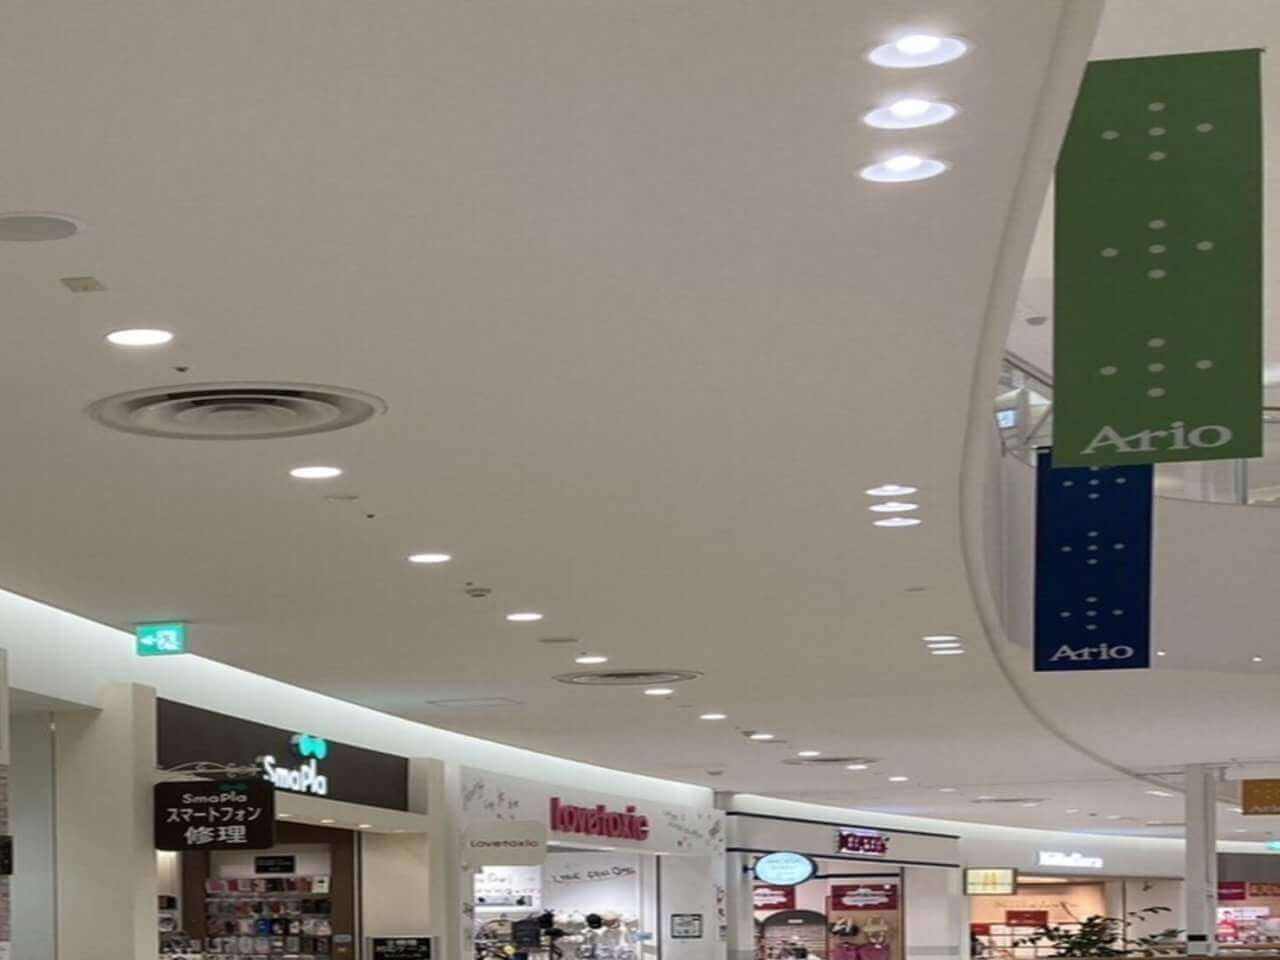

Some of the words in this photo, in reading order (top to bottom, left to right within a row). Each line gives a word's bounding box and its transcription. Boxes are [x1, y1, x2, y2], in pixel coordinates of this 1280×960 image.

[1080, 421, 1233, 455] Ario
[1049, 643, 1134, 661] Ario
[182, 790, 248, 804] SmaPla
[166, 806, 262, 823] スマートフォン
[184, 825, 249, 846] 修理
